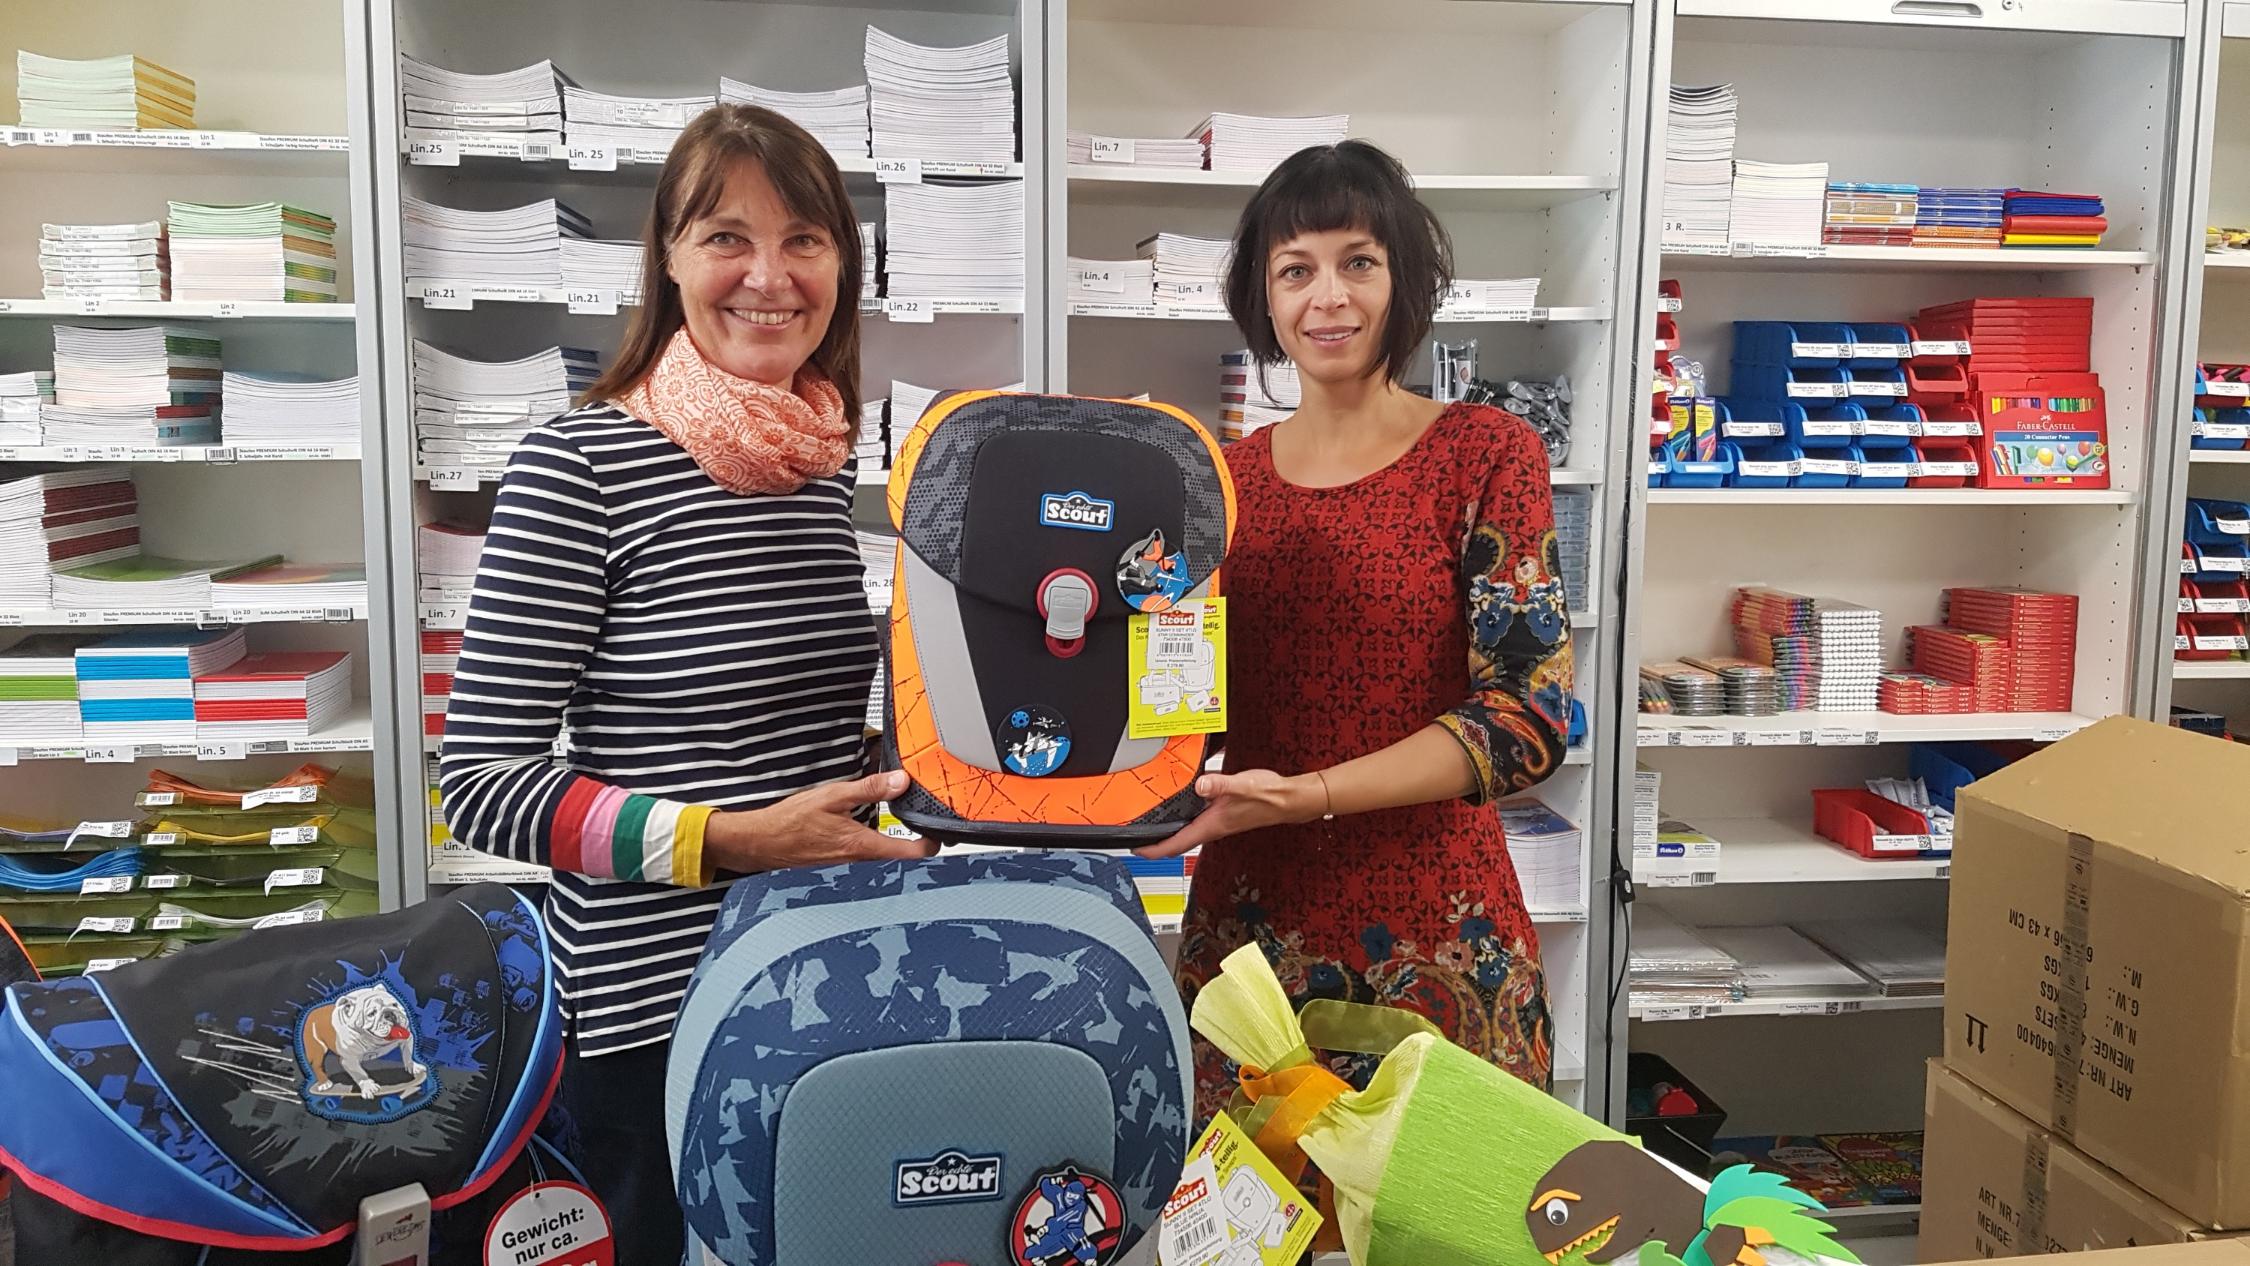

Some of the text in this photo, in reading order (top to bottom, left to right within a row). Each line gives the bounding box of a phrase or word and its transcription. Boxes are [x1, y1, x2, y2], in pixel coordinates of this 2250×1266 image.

[1094, 142, 1119, 152] Lin. 7
[591, 150, 603, 159] 25
[876, 162, 906, 172] Lin.26
[1084, 272, 1109, 281] Lin. 4
[1178, 285, 1202, 294] Lin. 4
[889, 302, 918, 312] Lin.22
[2017, 421, 2076, 430] FABER-CASTELL
[430, 471, 462, 480] Lin.27
[1048, 502, 1107, 524] Scout
[428, 609, 456, 618] Lin. 7
[1160, 614, 1194, 624] Scout
[85, 749, 114, 759] Lin. 4
[198, 747, 226, 755] Lin. 5
[888, 828, 905, 836] Lin.
[444, 842, 461, 851] Lin.
[2009, 908, 2025, 929] CM
[2028, 918, 2041, 937] 43
[2090, 1036, 2134, 1074] MENGE:
[2109, 1077, 2132, 1101] ART
[901, 1167, 995, 1195] Scout
[1164, 1181, 1205, 1217] Scout
[1978, 1186, 1996, 1209] ART
[502, 1207, 585, 1248] Gewicht:
[516, 1232, 578, 1264] nur ca.
